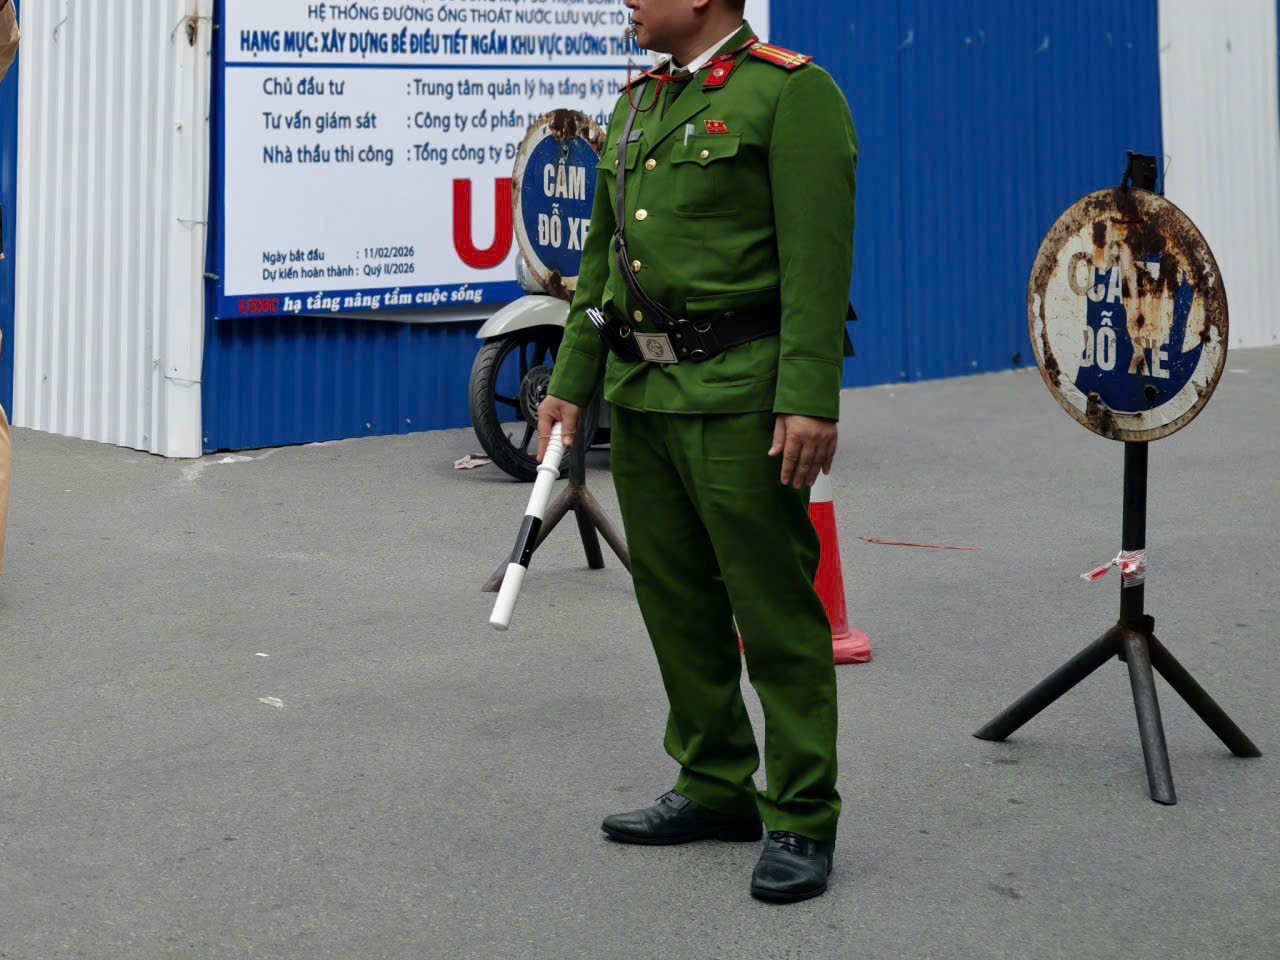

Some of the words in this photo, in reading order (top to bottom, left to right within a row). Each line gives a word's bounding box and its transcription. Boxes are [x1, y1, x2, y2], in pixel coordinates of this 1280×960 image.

[308, 2, 326, 22] HỆ
[329, 2, 379, 21] THỐNG
[383, 5, 434, 21] ĐƯỜNG
[470, 8, 512, 23] THOÁT
[515, 9, 552, 25] NƯỚC
[582, 10, 608, 27] VỰC
[609, 10, 625, 25] TÔ
[240, 30, 280, 58] HẠNG
[283, 30, 318, 58] MỤC:
[321, 27, 346, 53] XÂY
[349, 29, 388, 59] DỰNG
[442, 28, 468, 55] TIẾT
[510, 34, 536, 56] KHU
[538, 32, 563, 60] VỰC
[565, 31, 607, 56] ĐƯỜNG
[262, 76, 293, 95] Chủ
[328, 79, 345, 95] tư
[413, 79, 454, 100] Trung
[457, 79, 484, 96] tâm
[487, 78, 520, 101] quản
[524, 78, 536, 100] lý
[539, 78, 554, 99] hạ
[262, 112, 282, 129] Tư
[285, 110, 311, 129] vấn
[315, 112, 352, 133] giám
[356, 112, 377, 129] sát
[414, 111, 450, 132] Công
[454, 113, 468, 132] ty
[263, 146, 293, 163] Nhà
[334, 146, 354, 163] thi
[358, 144, 393, 166] công
[452, 143, 485, 165] công
[489, 145, 502, 165] ty
[538, 203, 562, 248] ĐỖ
[262, 251, 287, 265] Ngày
[289, 249, 304, 262] bắt
[364, 246, 415, 259] 11/02/2026
[262, 268, 277, 281] Dự
[279, 267, 299, 279] kiến
[301, 267, 325, 279] hoàn
[326, 265, 354, 278] thành
[363, 264, 383, 278] Quý
[384, 262, 415, 275] II/2026
[283, 296, 302, 313] hạ
[344, 291, 380, 310] nâng
[415, 288, 447, 304] cuộc
[451, 284, 483, 304] sống
